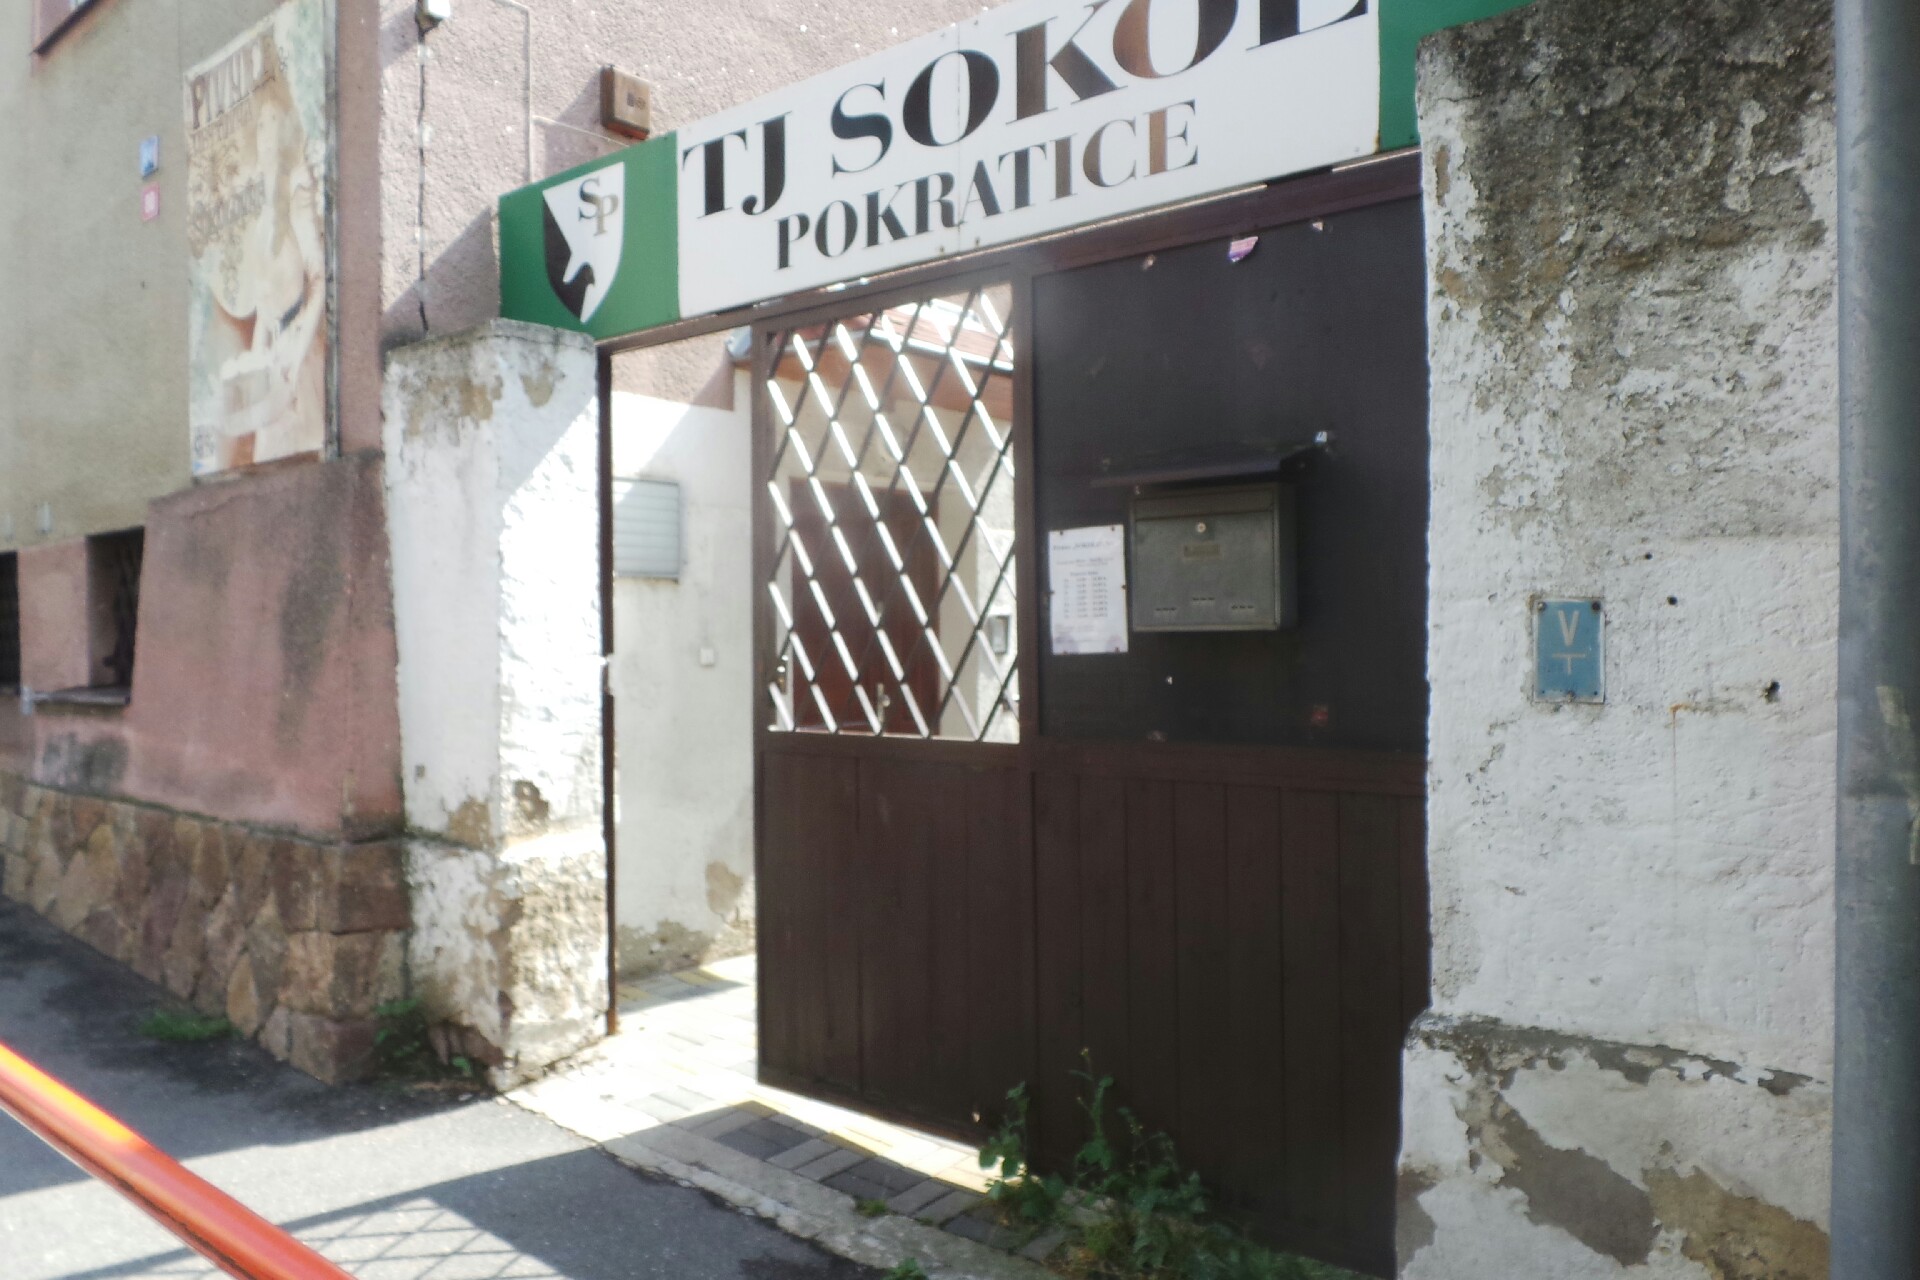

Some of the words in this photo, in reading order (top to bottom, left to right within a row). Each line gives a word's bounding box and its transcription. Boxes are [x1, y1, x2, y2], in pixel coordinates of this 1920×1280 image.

[682, 110, 793, 219] TJ
[774, 99, 1197, 270] POKRATICE
[1558, 610, 1580, 647] V
